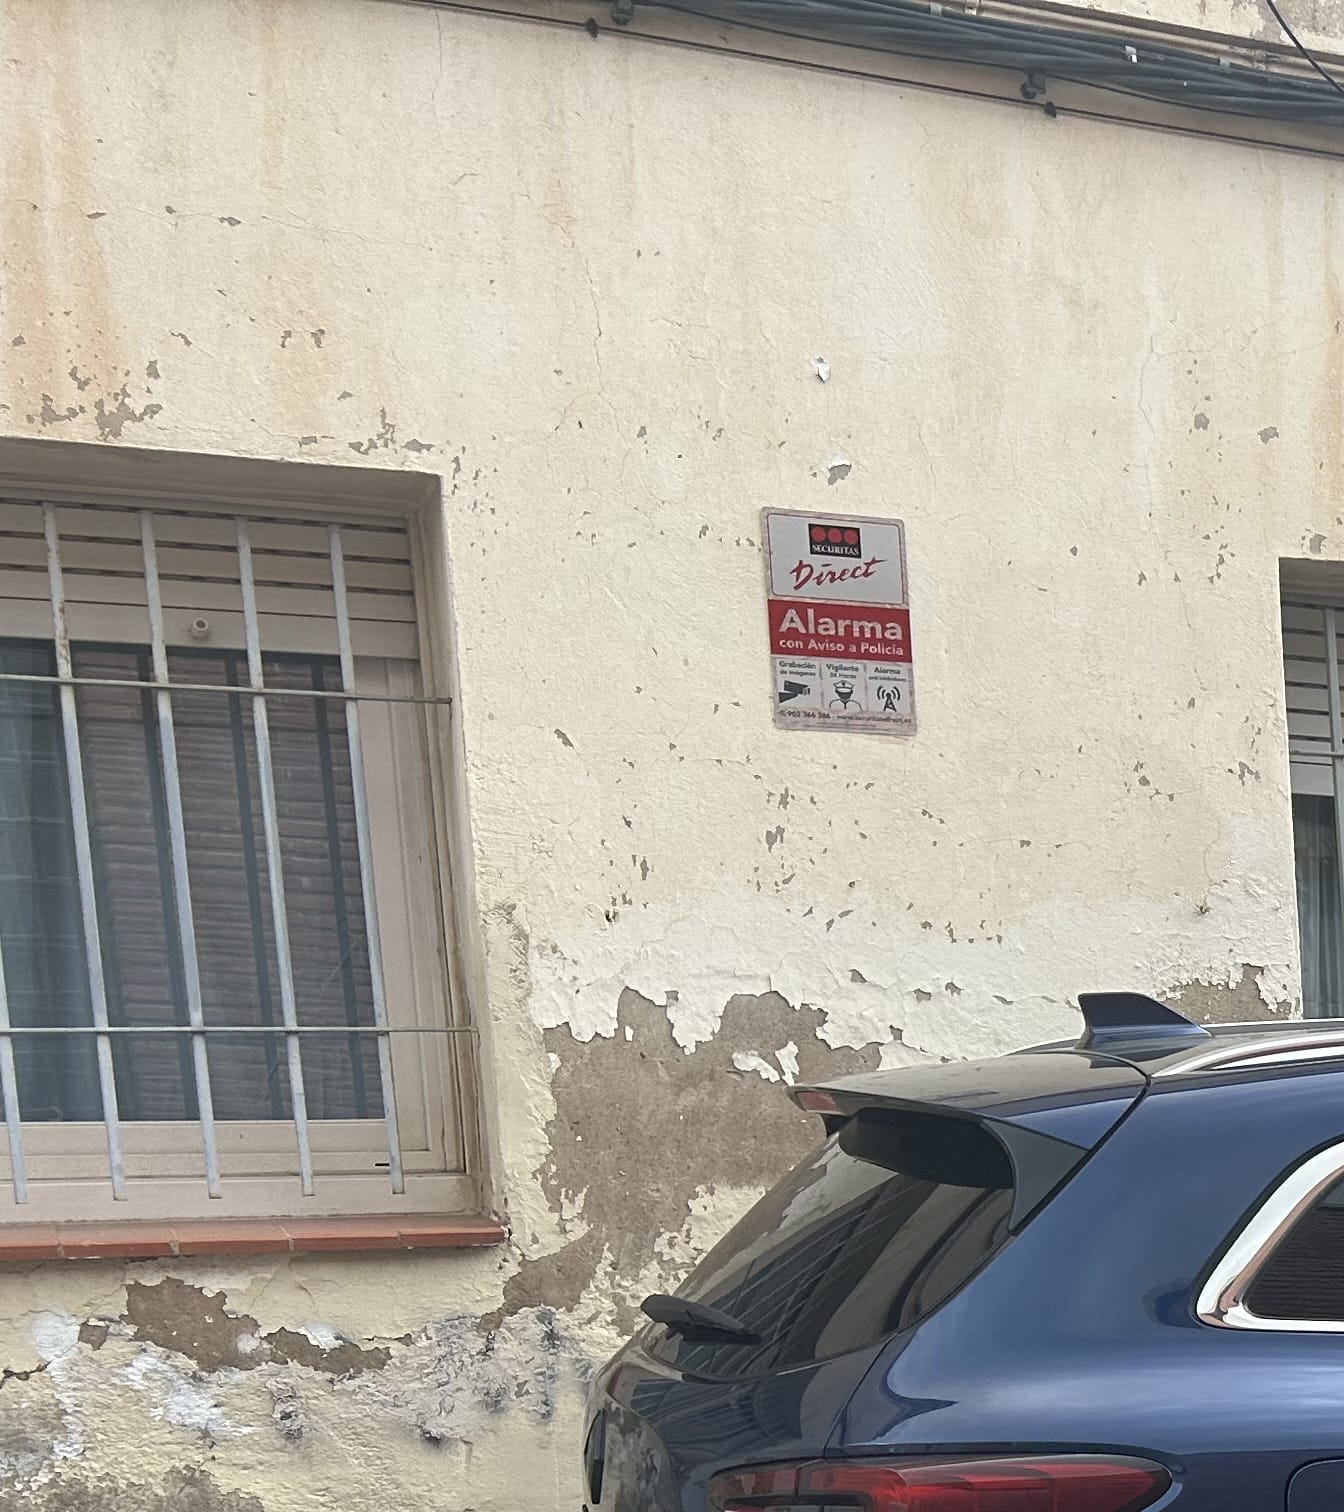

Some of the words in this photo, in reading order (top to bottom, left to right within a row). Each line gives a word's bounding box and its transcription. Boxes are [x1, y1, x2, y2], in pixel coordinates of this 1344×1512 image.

[812, 544, 859, 555] SECURITAS
[790, 556, 888, 590] Direct
[779, 608, 902, 640] Alarma
[780, 638, 803, 649] con
[808, 639, 845, 652] Aviso
[848, 643, 856, 653] a
[861, 642, 904, 656] Policía
[874, 666, 901, 675] Alarma
